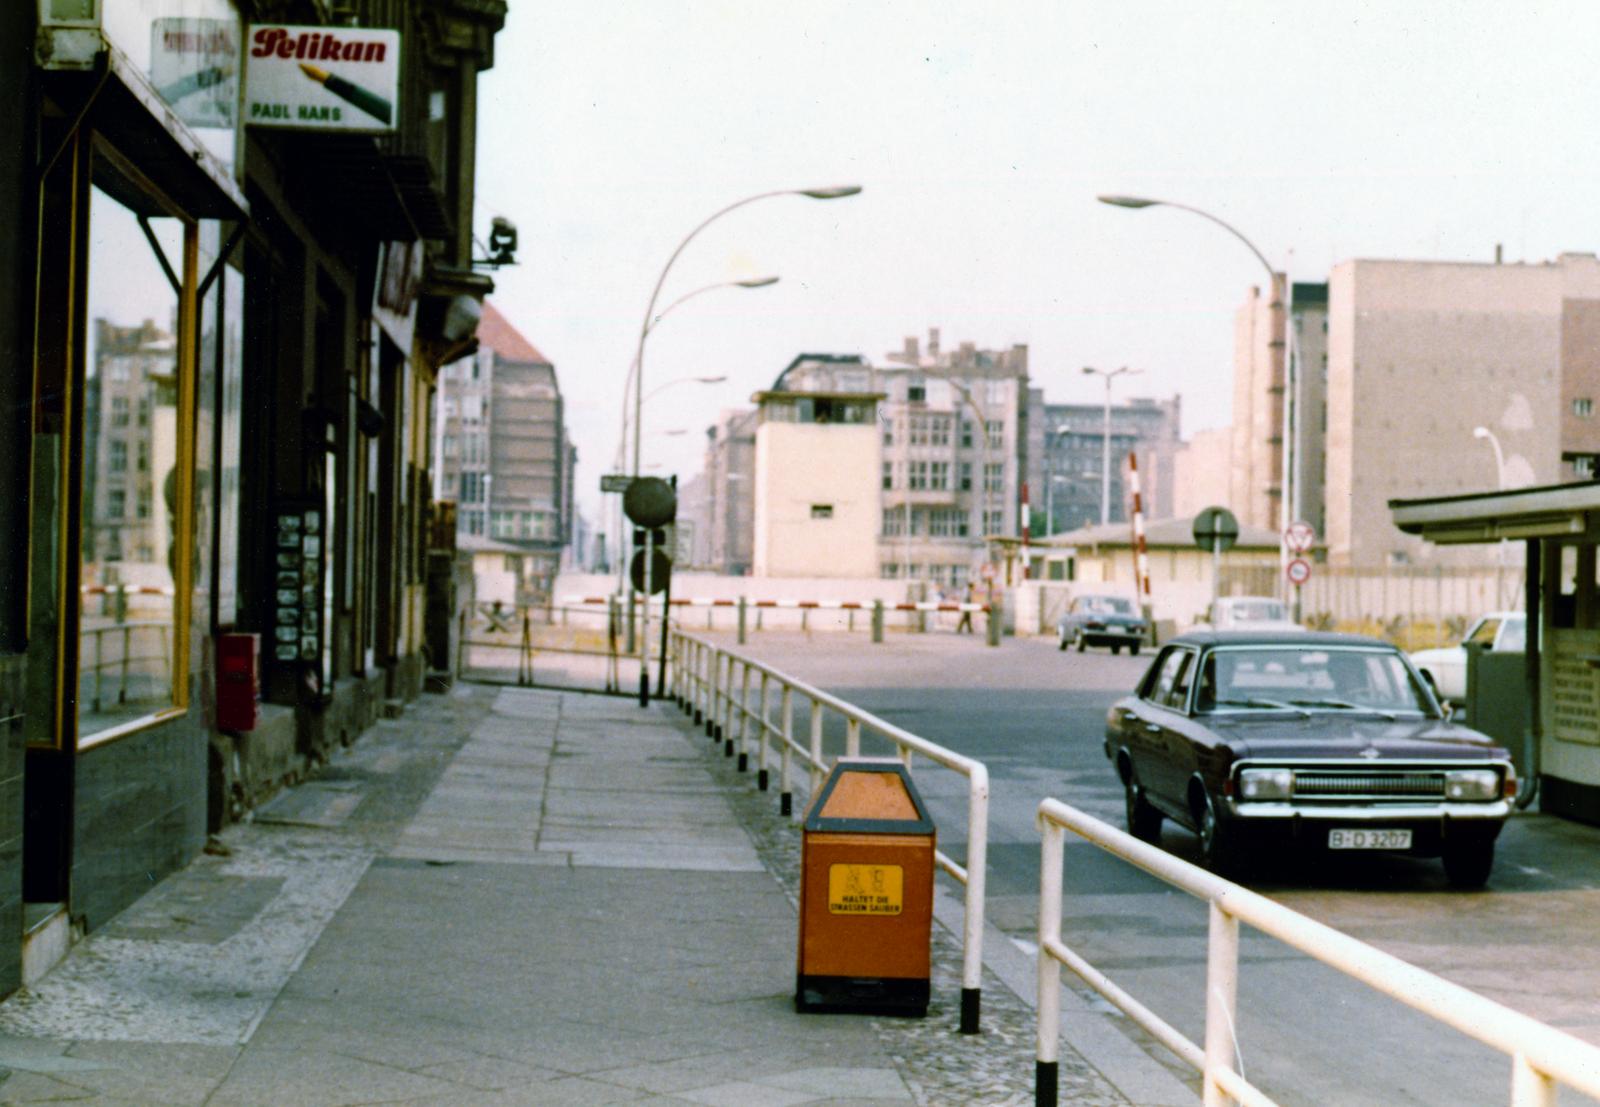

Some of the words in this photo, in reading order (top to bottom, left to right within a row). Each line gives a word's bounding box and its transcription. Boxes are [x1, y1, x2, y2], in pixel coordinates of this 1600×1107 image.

[251, 28, 387, 62] Pelikan
[251, 102, 291, 119] PAUL
[298, 105, 341, 121] HANS
[1371, 831, 1408, 847] 3207
